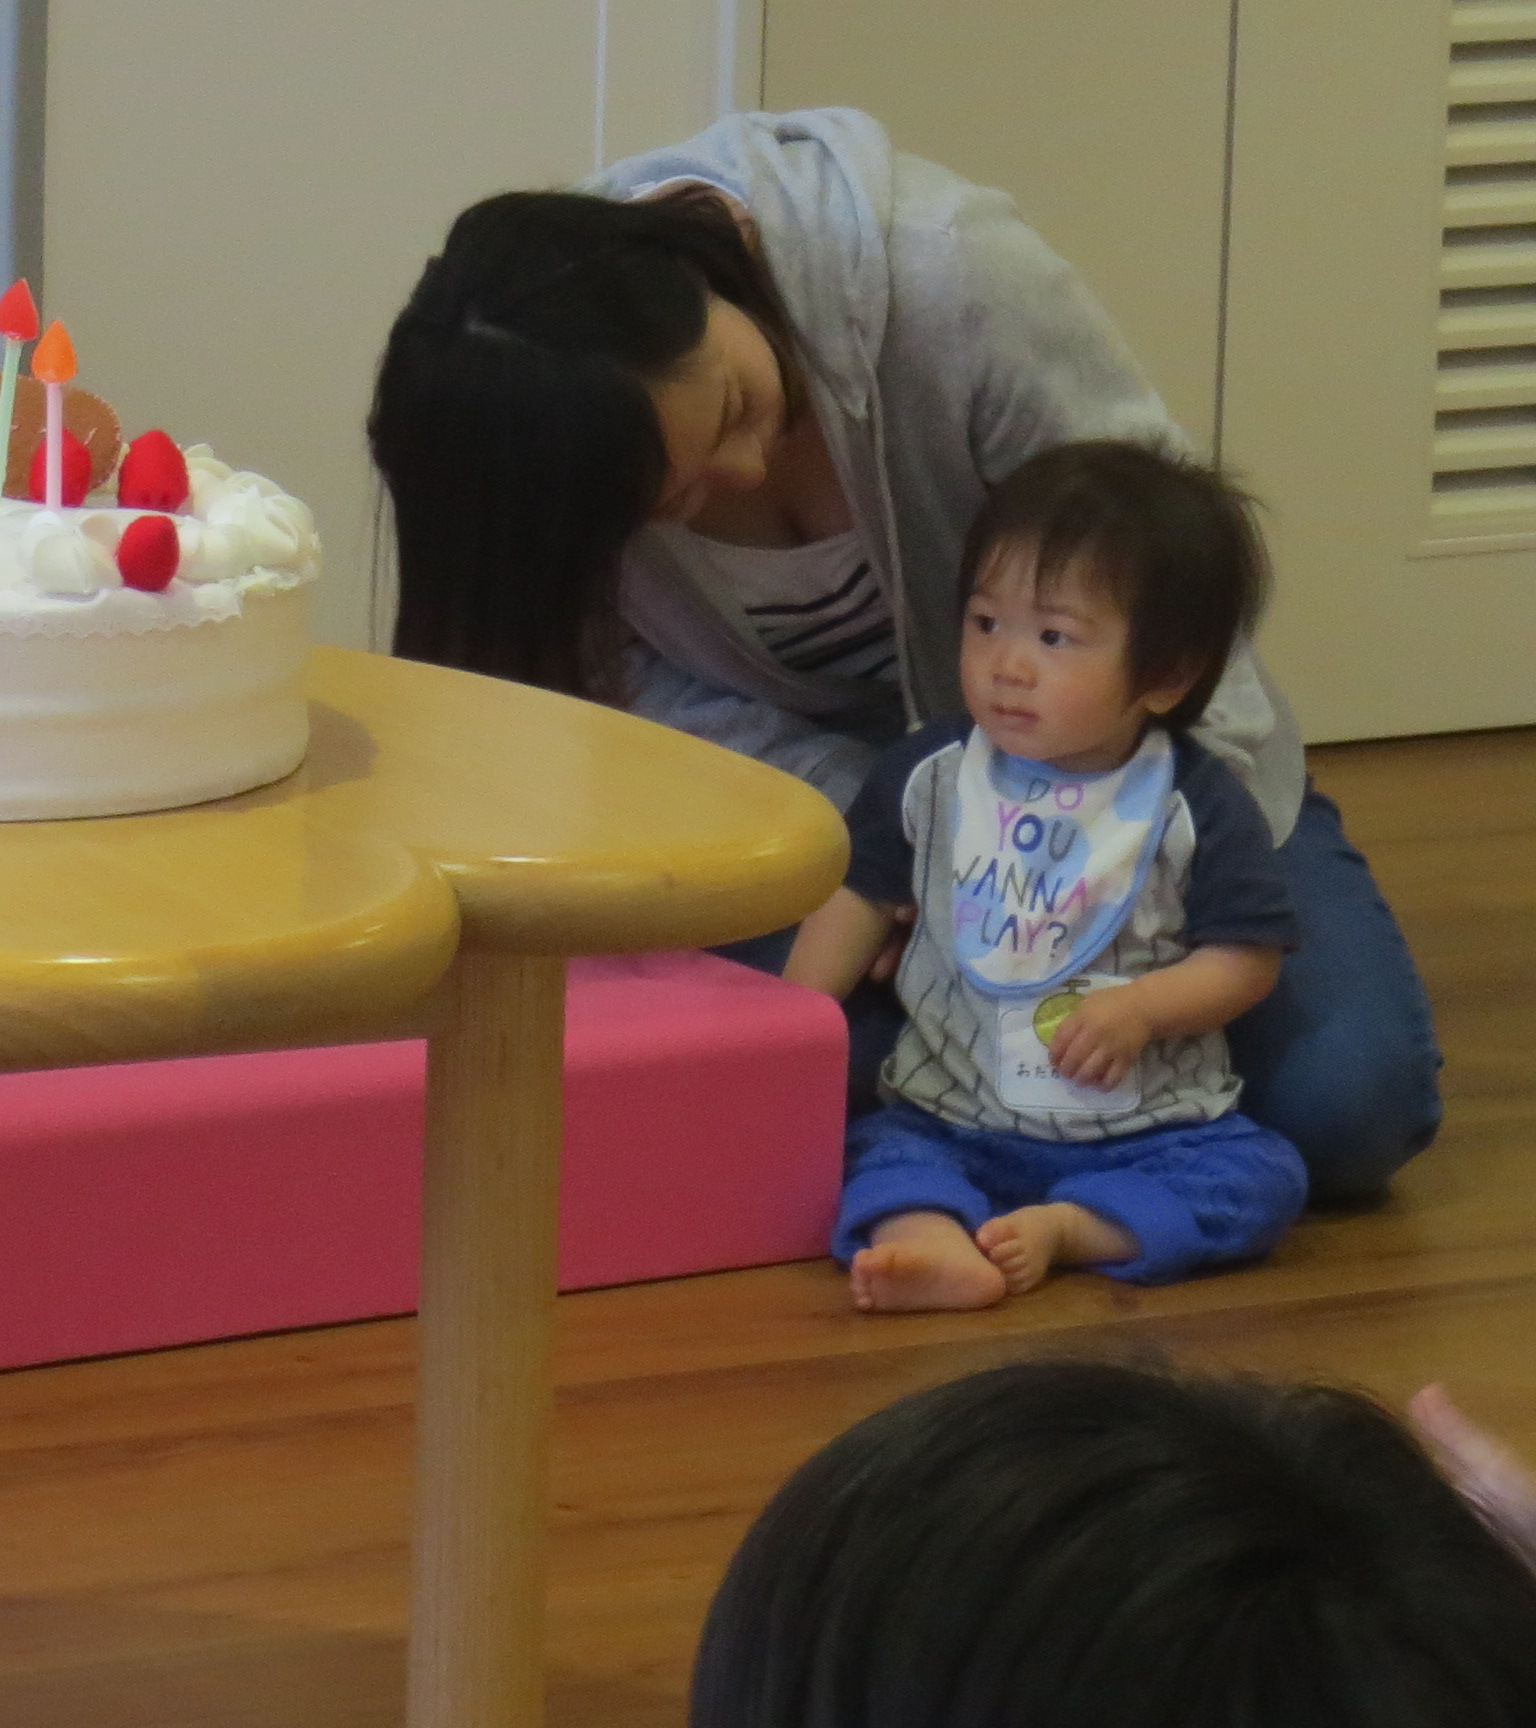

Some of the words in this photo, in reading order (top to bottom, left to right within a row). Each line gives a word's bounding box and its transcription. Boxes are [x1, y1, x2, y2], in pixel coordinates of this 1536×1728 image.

[1025, 778, 1084, 811] DO
[997, 801, 1078, 862] YOU
[954, 901, 1068, 958] PLAY?
